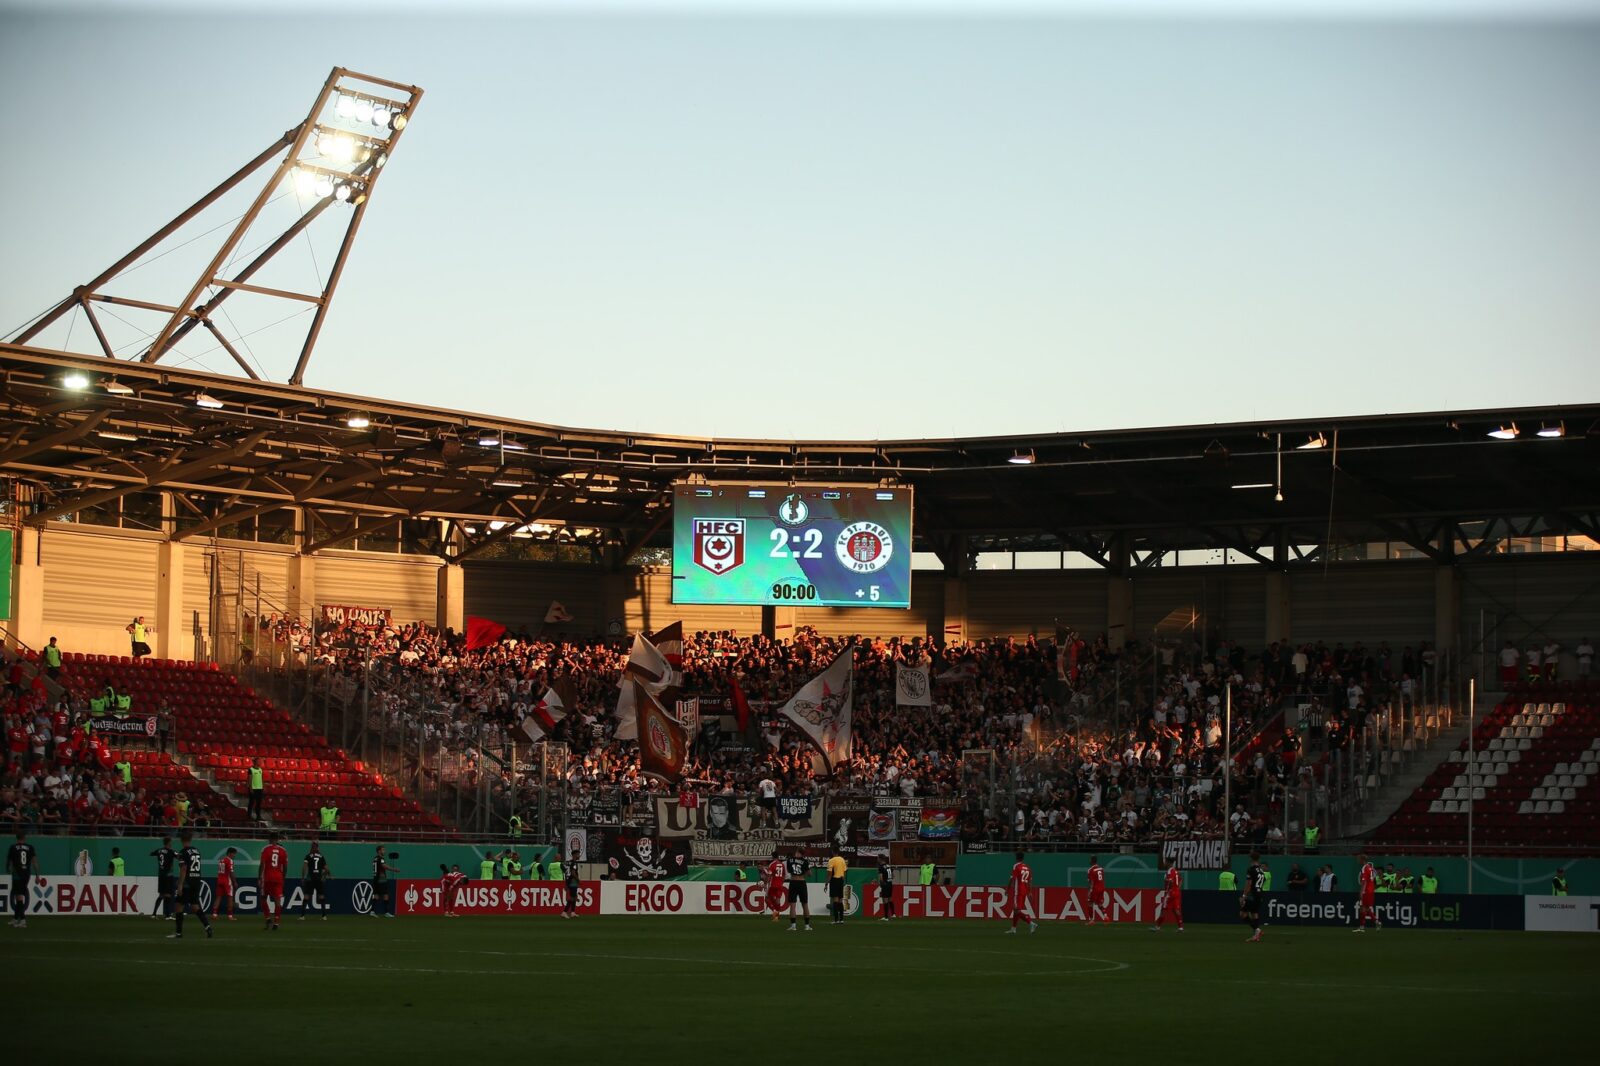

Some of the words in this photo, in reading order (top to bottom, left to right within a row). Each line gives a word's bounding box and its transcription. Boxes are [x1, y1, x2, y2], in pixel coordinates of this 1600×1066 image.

[698, 522, 740, 534] HFC
[838, 534, 848, 546] FC
[848, 523, 861, 535] ST.
[864, 522, 892, 548] PAULI
[769, 528, 823, 559] 2:2
[852, 561, 876, 571] 1910
[772, 584, 816, 600] 90:00
[869, 585, 880, 601] 5
[327, 607, 344, 624] NO
[20, 851, 27, 865] 8
[271, 853, 279, 867] 9
[1163, 840, 1231, 869] VETERANEN
[190, 855, 201, 872] 25
[313, 857, 320, 870] 7
[775, 863, 783, 877] 31
[1020, 870, 1030, 883] 22
[57, 884, 139, 912] BANK
[422, 887, 500, 908] STAUSS
[625, 884, 684, 912] ERGO
[1268, 898, 1351, 925] freenet,
[1422, 901, 1462, 922] los!
